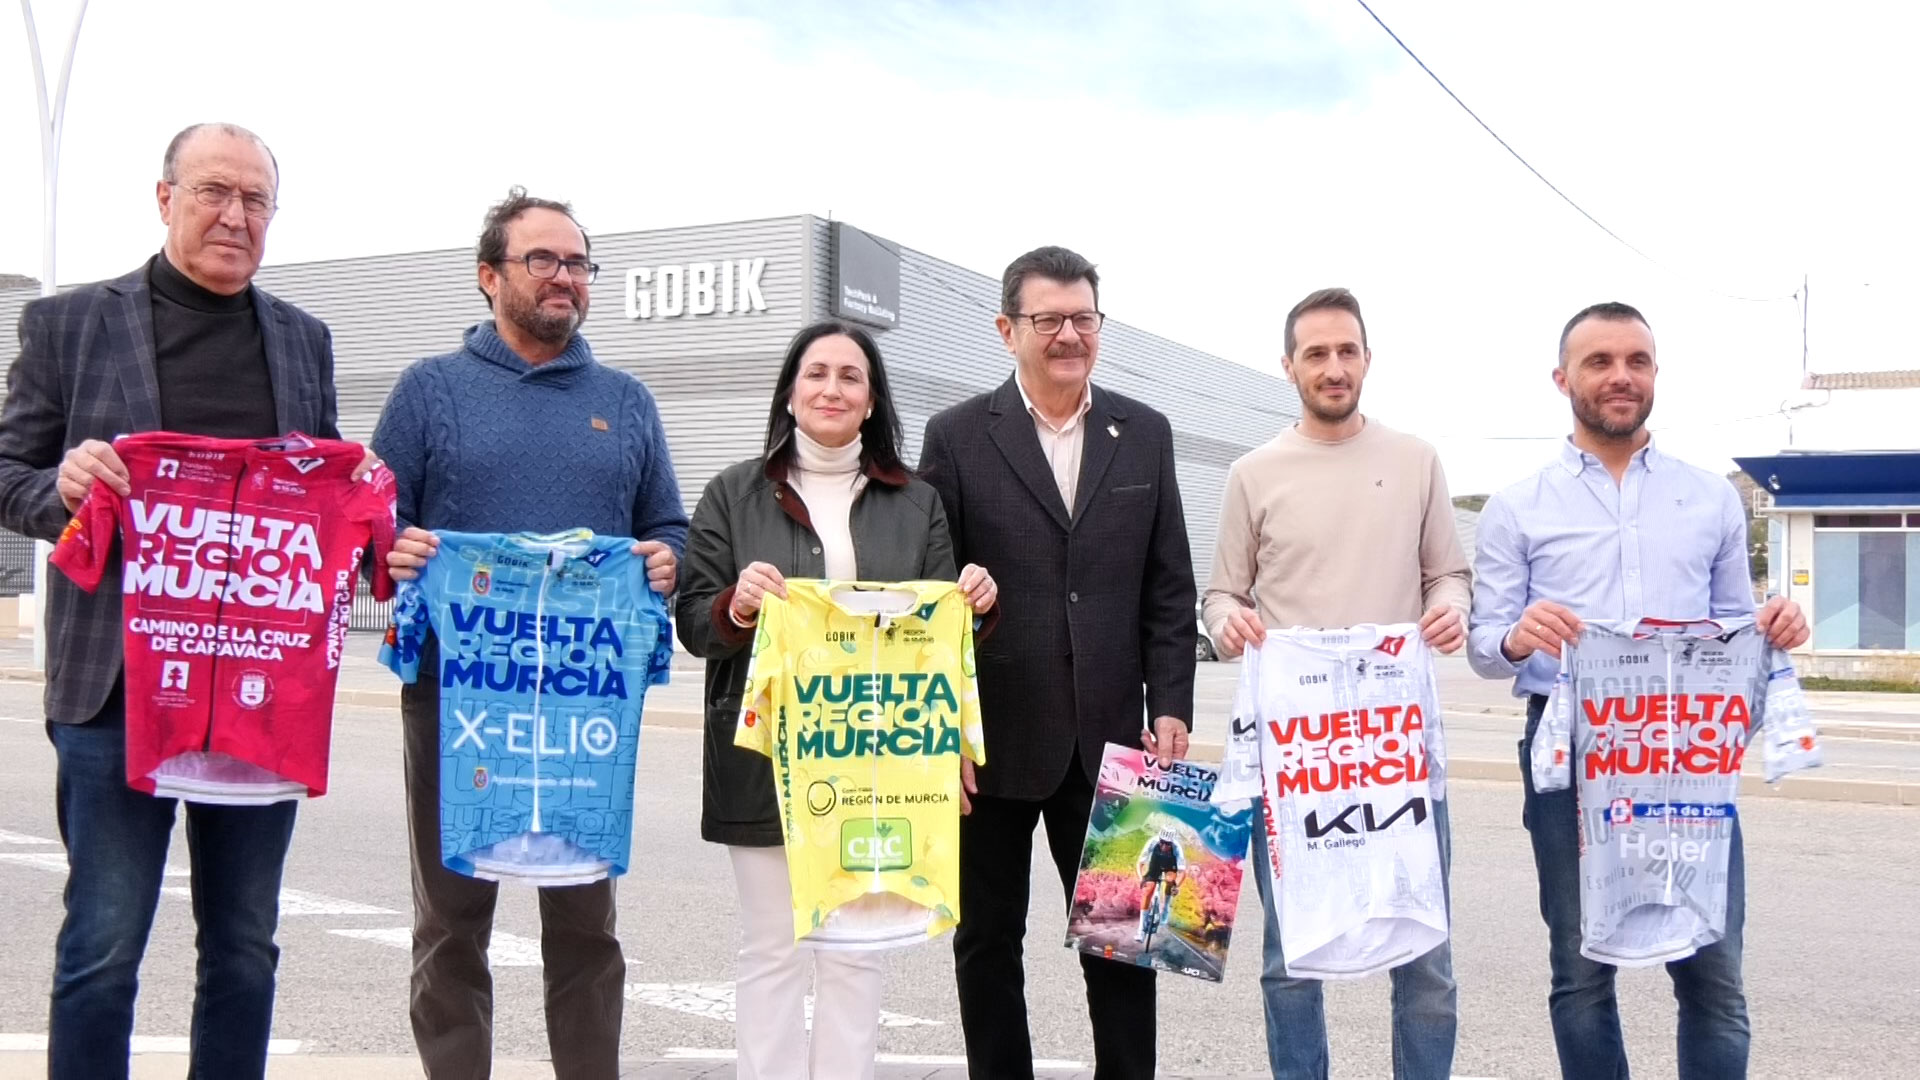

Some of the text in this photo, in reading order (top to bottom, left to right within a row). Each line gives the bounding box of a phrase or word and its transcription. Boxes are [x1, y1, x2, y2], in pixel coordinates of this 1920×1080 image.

[625, 257, 766, 318] GOBIK
[130, 499, 322, 570] VUELTA
[123, 561, 324, 613] MURCIA
[129, 617, 312, 648] CAMINO DE LA CRUZ
[152, 637, 178, 652] DE
[450, 603, 624, 658] VUELTA
[826, 631, 856, 642] GOBIK
[443, 659, 628, 700] MURCIA
[794, 673, 957, 713] VUELTA
[1299, 674, 1328, 685] GOBIK
[1267, 704, 1423, 745] VUELTA
[1582, 693, 1751, 735] VUELTA
[797, 727, 960, 760] MURCIA
[842, 793, 949, 805] REGIÓN DE MURCIA
[1644, 806, 1677, 816] Juan
[1681, 805, 1700, 816] de
[1304, 797, 1427, 838] KIA
[847, 835, 904, 859] CRC
[1324, 837, 1365, 849] Gallego
[1620, 832, 1711, 863] Haier
